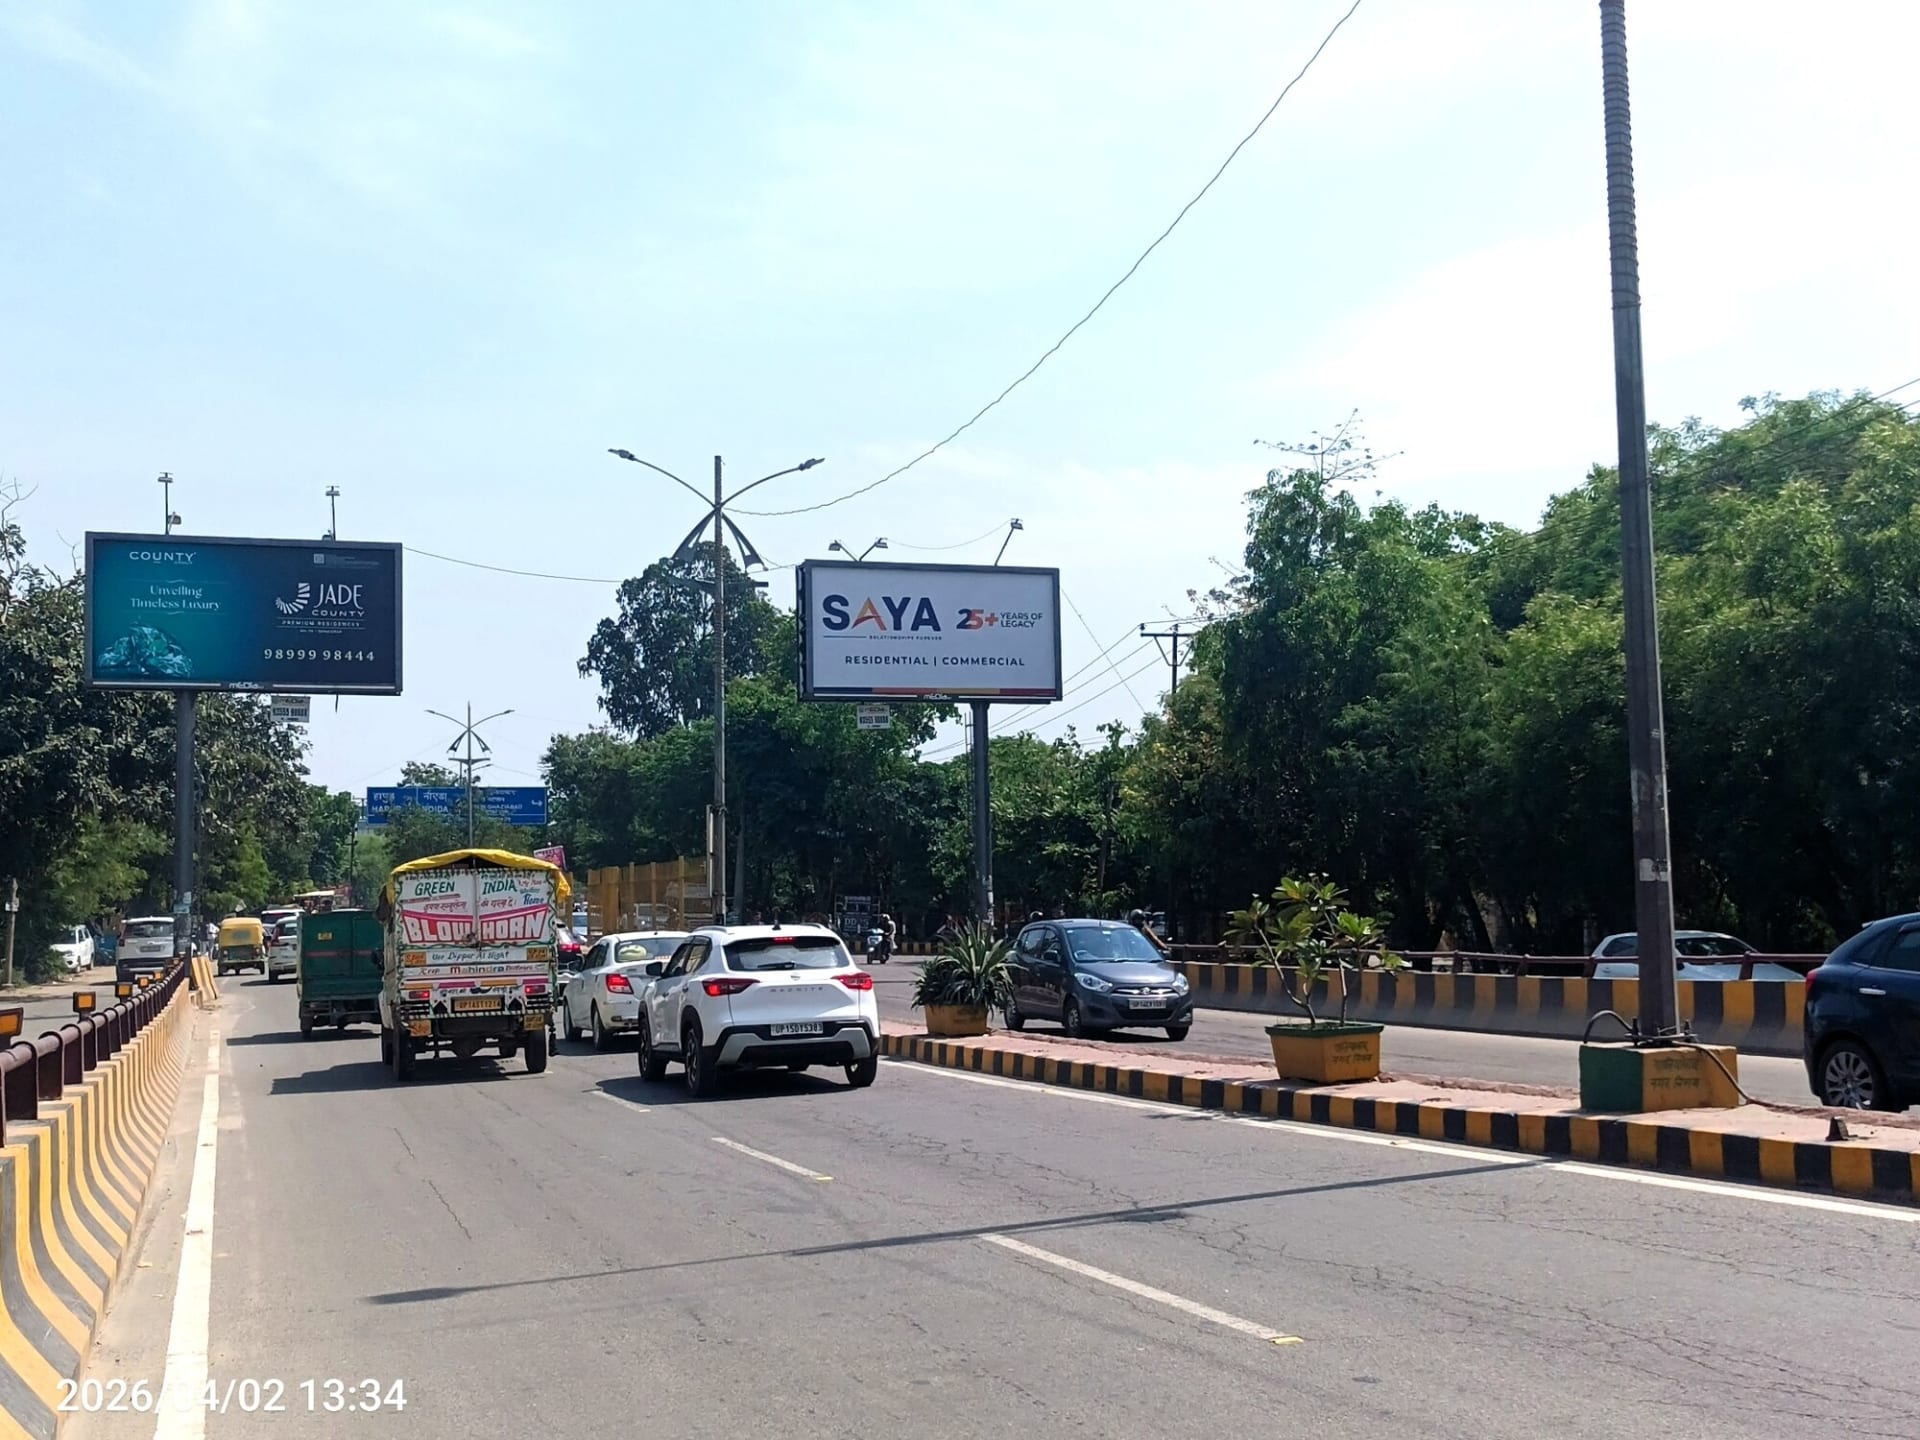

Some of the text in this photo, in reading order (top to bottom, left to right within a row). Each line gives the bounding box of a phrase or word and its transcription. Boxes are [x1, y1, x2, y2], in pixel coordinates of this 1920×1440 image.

[129, 551, 196, 562] COUNTY
[150, 584, 203, 599] Unveiling
[313, 583, 364, 609] JADE
[130, 597, 221, 611] Timeless Luxury
[311, 609, 366, 617] COUNTY
[822, 594, 942, 632] SAYA
[956, 608, 999, 630] 25+
[1000, 612, 1043, 620] YEARS OF
[1000, 620, 1035, 628] LEGACY
[264, 648, 375, 661] 98999 98444
[845, 655, 1025, 667] RESIDENTIAL COMMERCIAL
[415, 880, 455, 897] GREEN
[482, 879, 518, 895] INDIA
[405, 908, 547, 943] BLOW HORN
